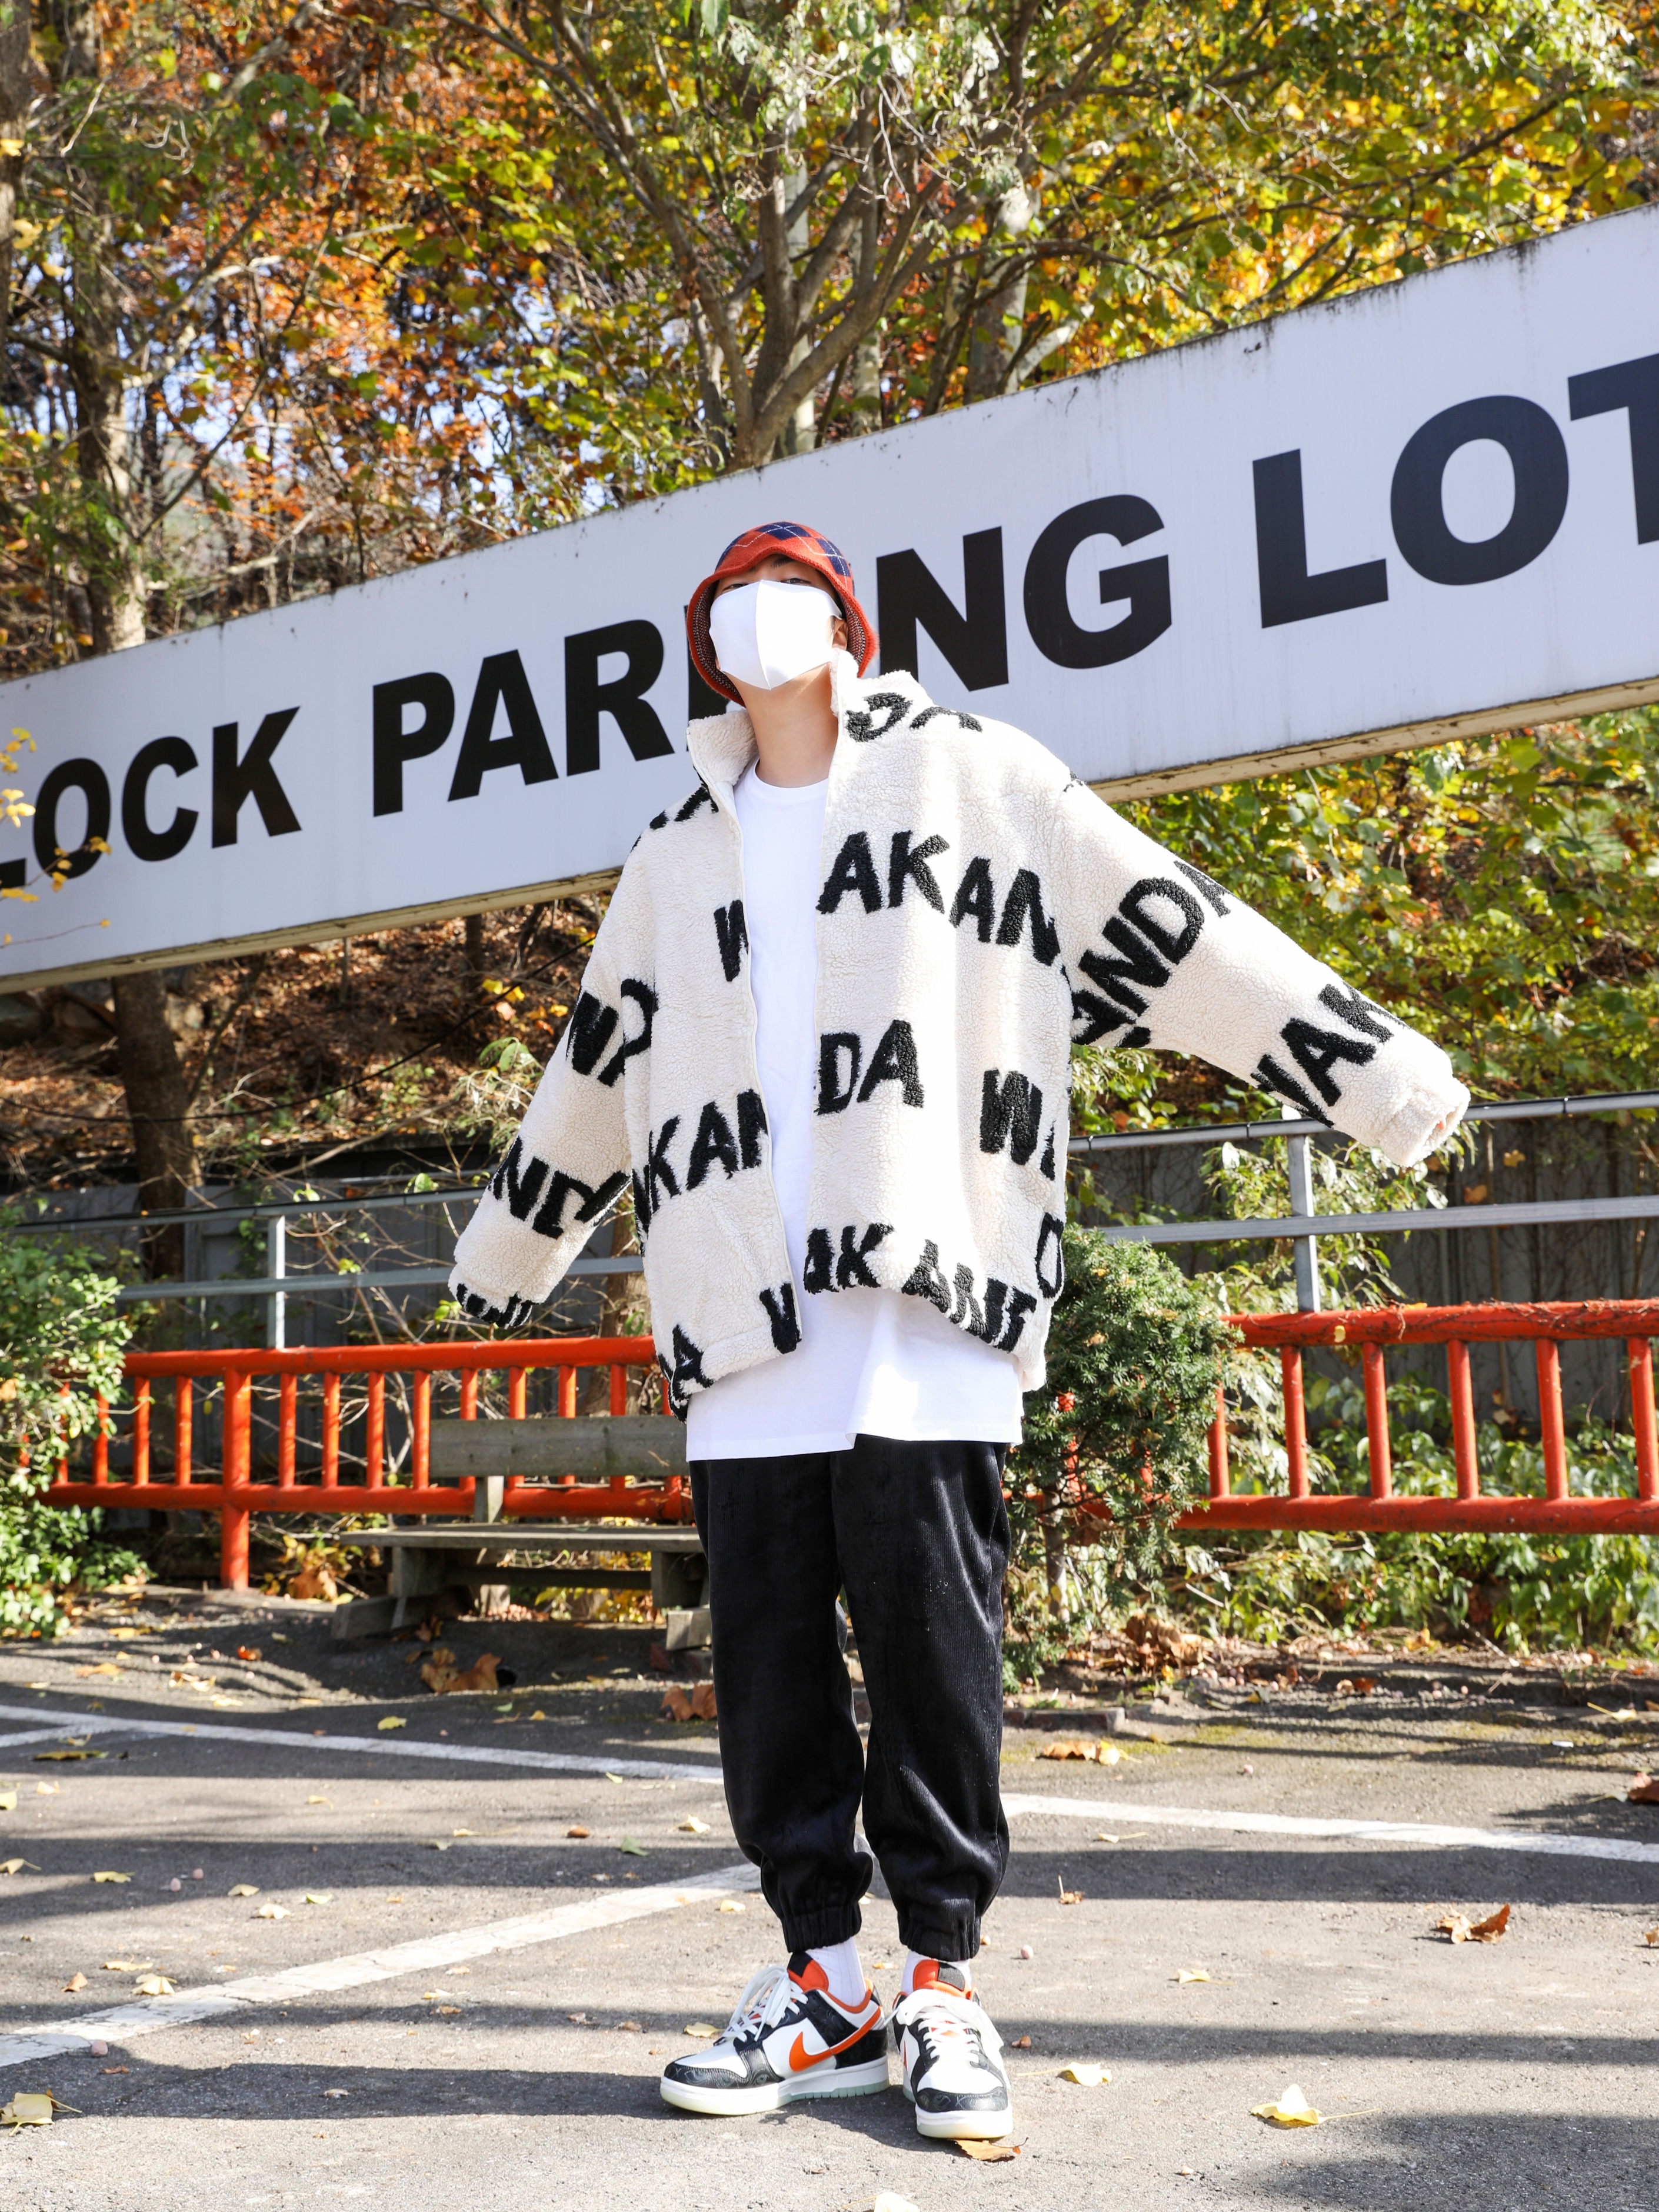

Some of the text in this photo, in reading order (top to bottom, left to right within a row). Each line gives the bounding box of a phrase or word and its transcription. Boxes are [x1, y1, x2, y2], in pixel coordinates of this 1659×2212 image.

[0, 352, 1659, 890] OCK PARNG LOT
